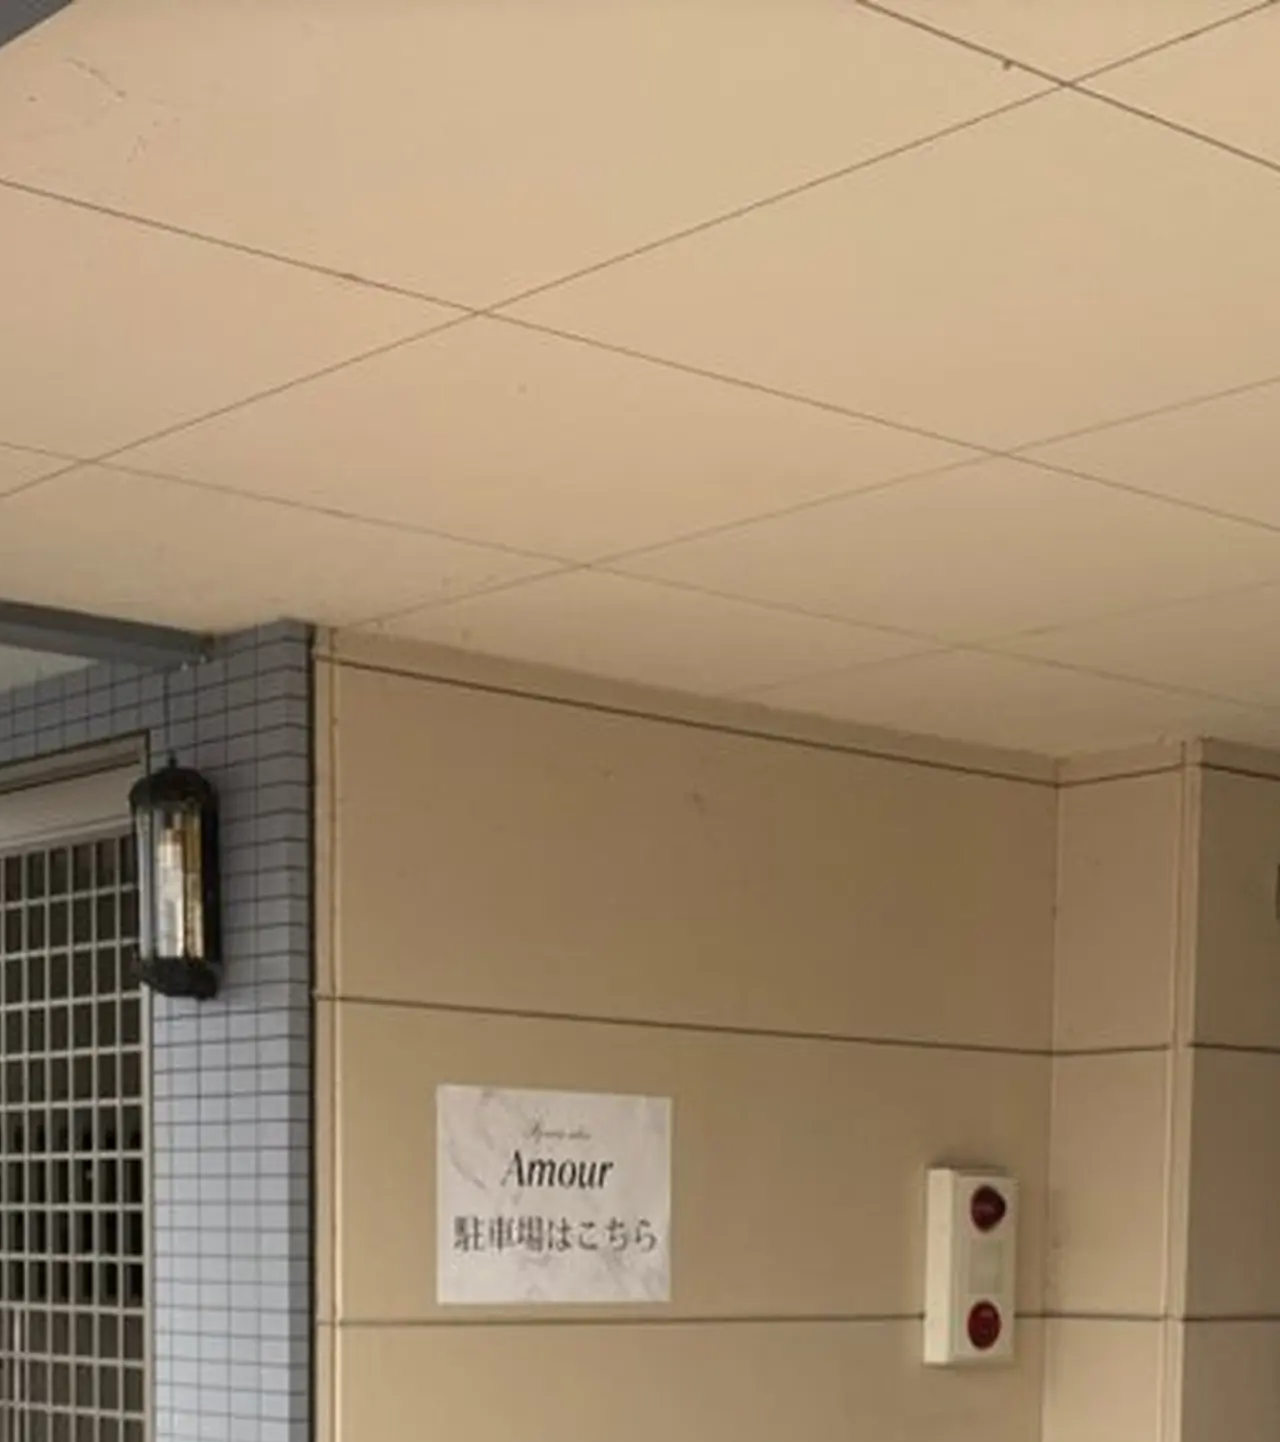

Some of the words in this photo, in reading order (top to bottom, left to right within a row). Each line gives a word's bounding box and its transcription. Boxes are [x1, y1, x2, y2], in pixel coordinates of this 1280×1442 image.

[500, 1150, 614, 1189] Amour
[453, 1215, 659, 1253] 駐車場はこちら
